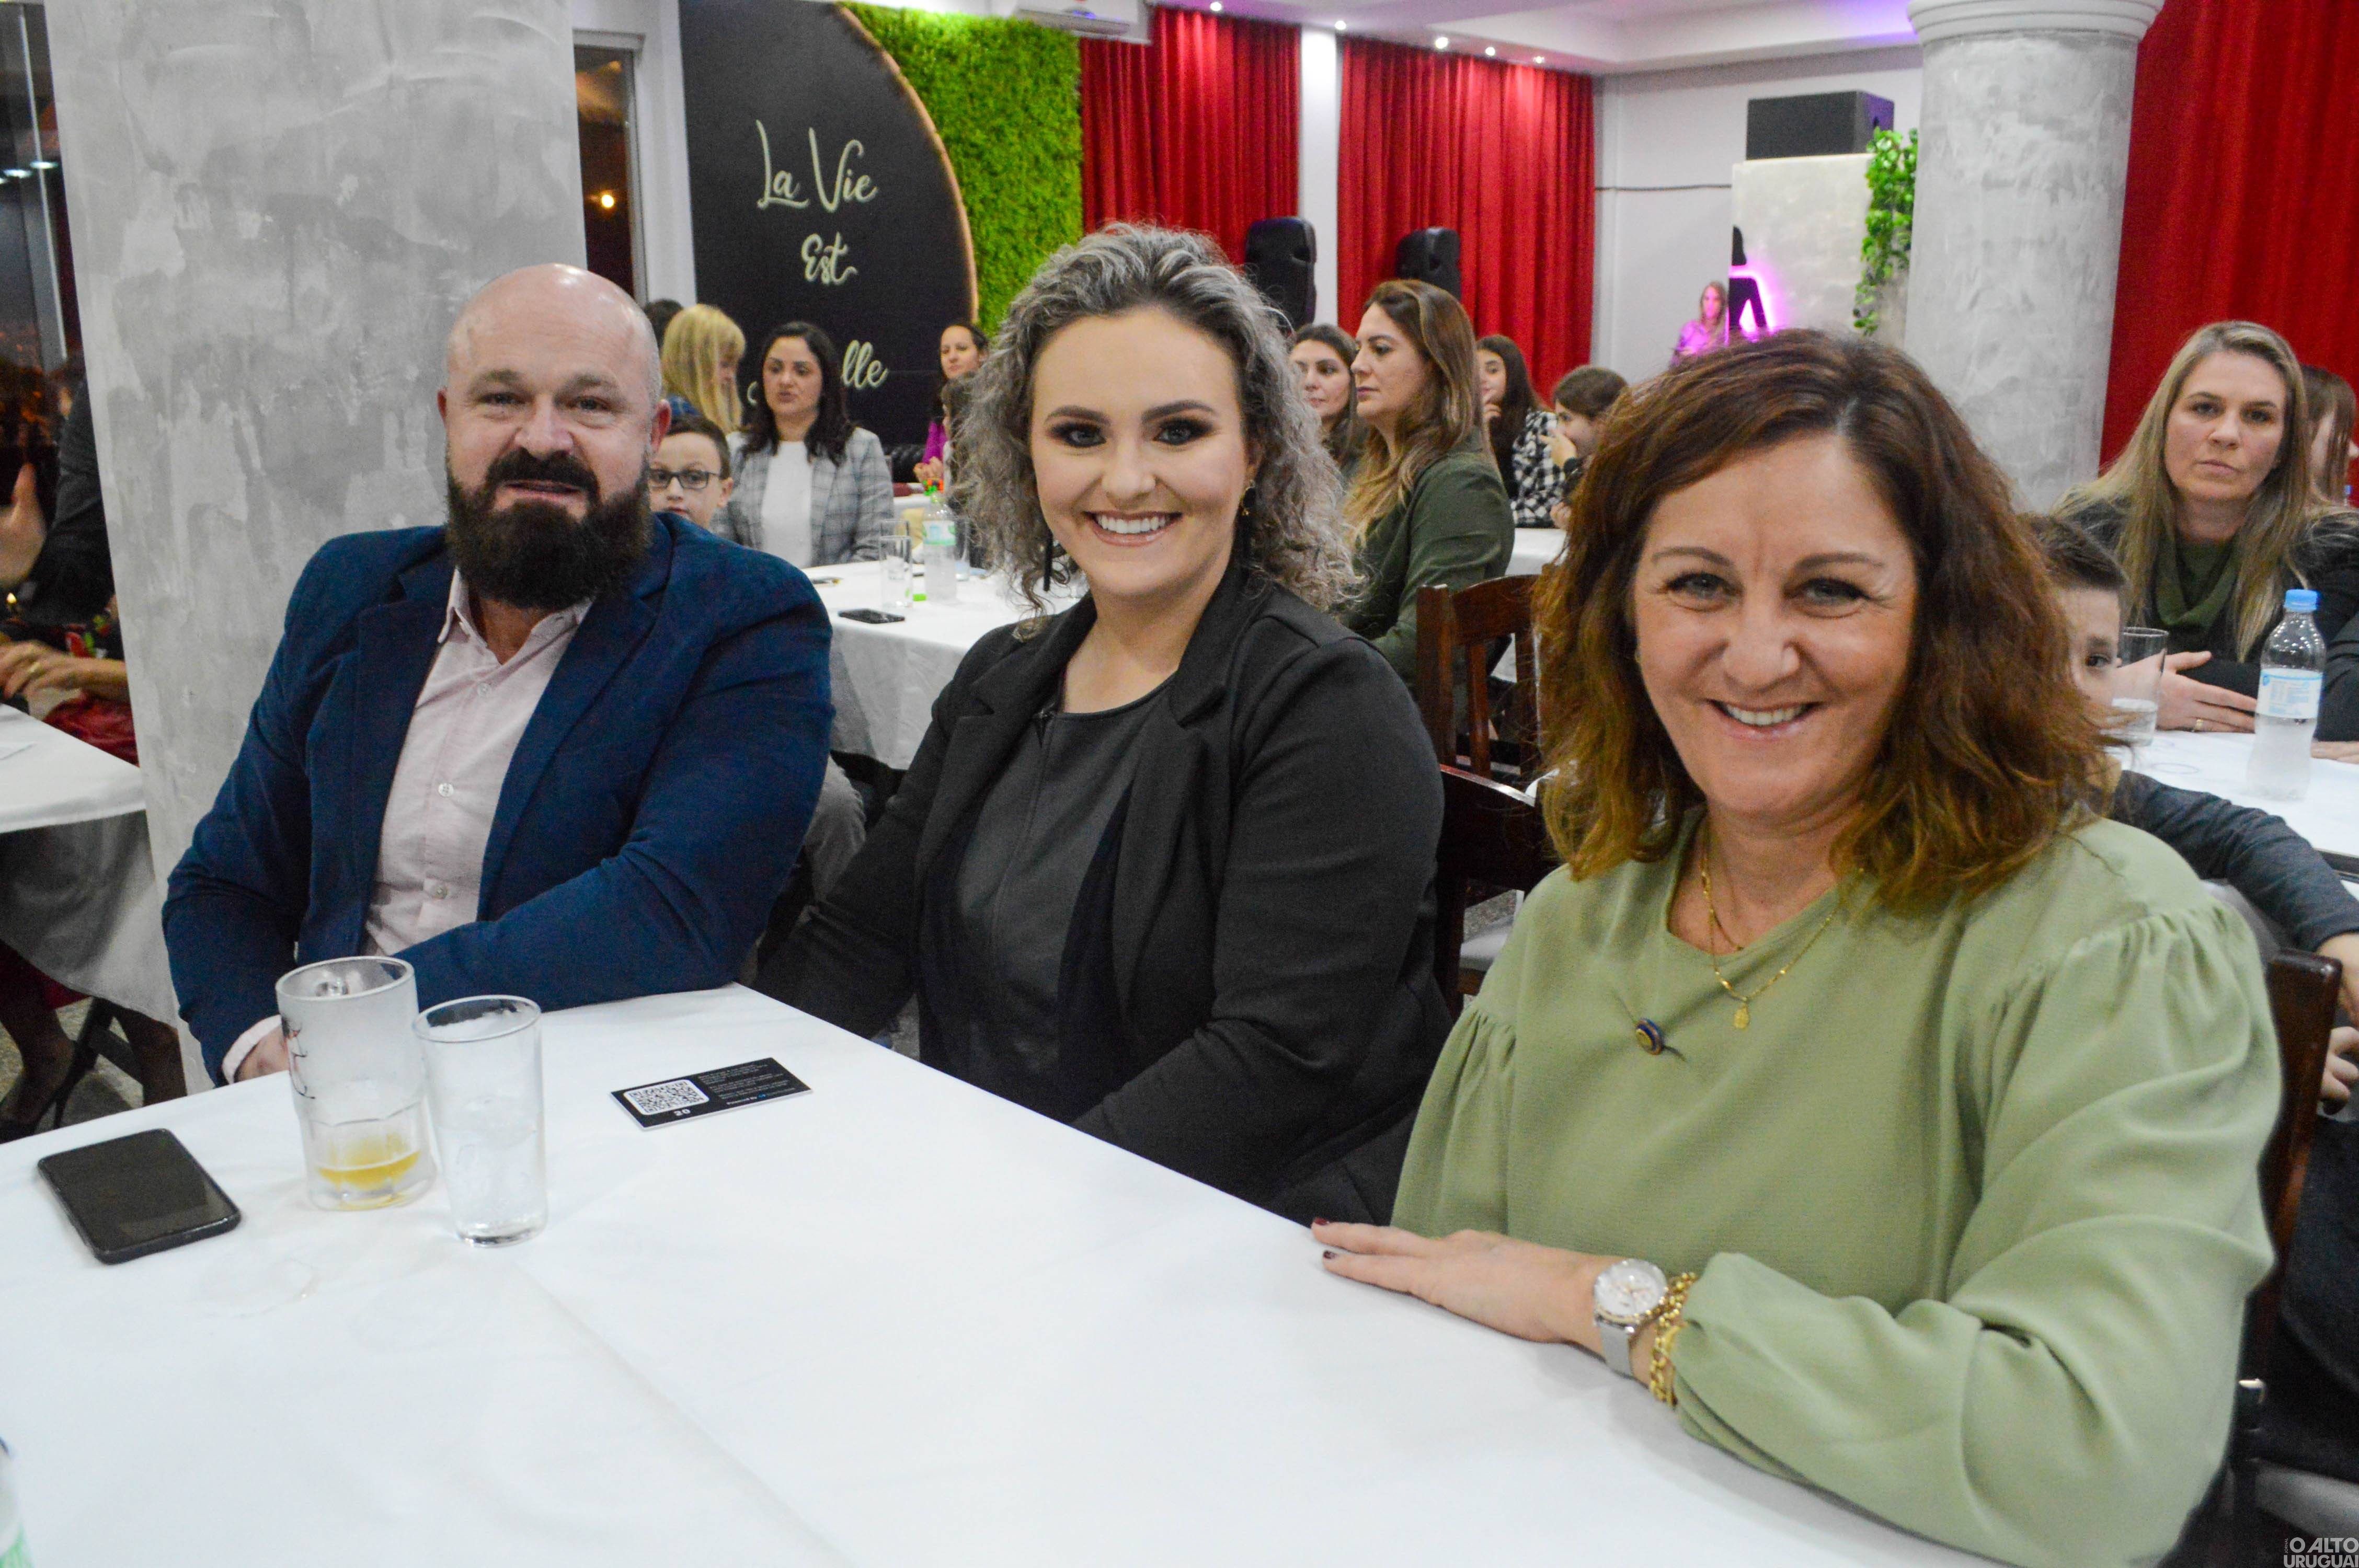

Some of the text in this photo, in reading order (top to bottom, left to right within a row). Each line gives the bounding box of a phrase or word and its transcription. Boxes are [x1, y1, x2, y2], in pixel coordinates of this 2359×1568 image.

[757, 119, 877, 213] La Vie
[801, 232, 857, 285] Est
